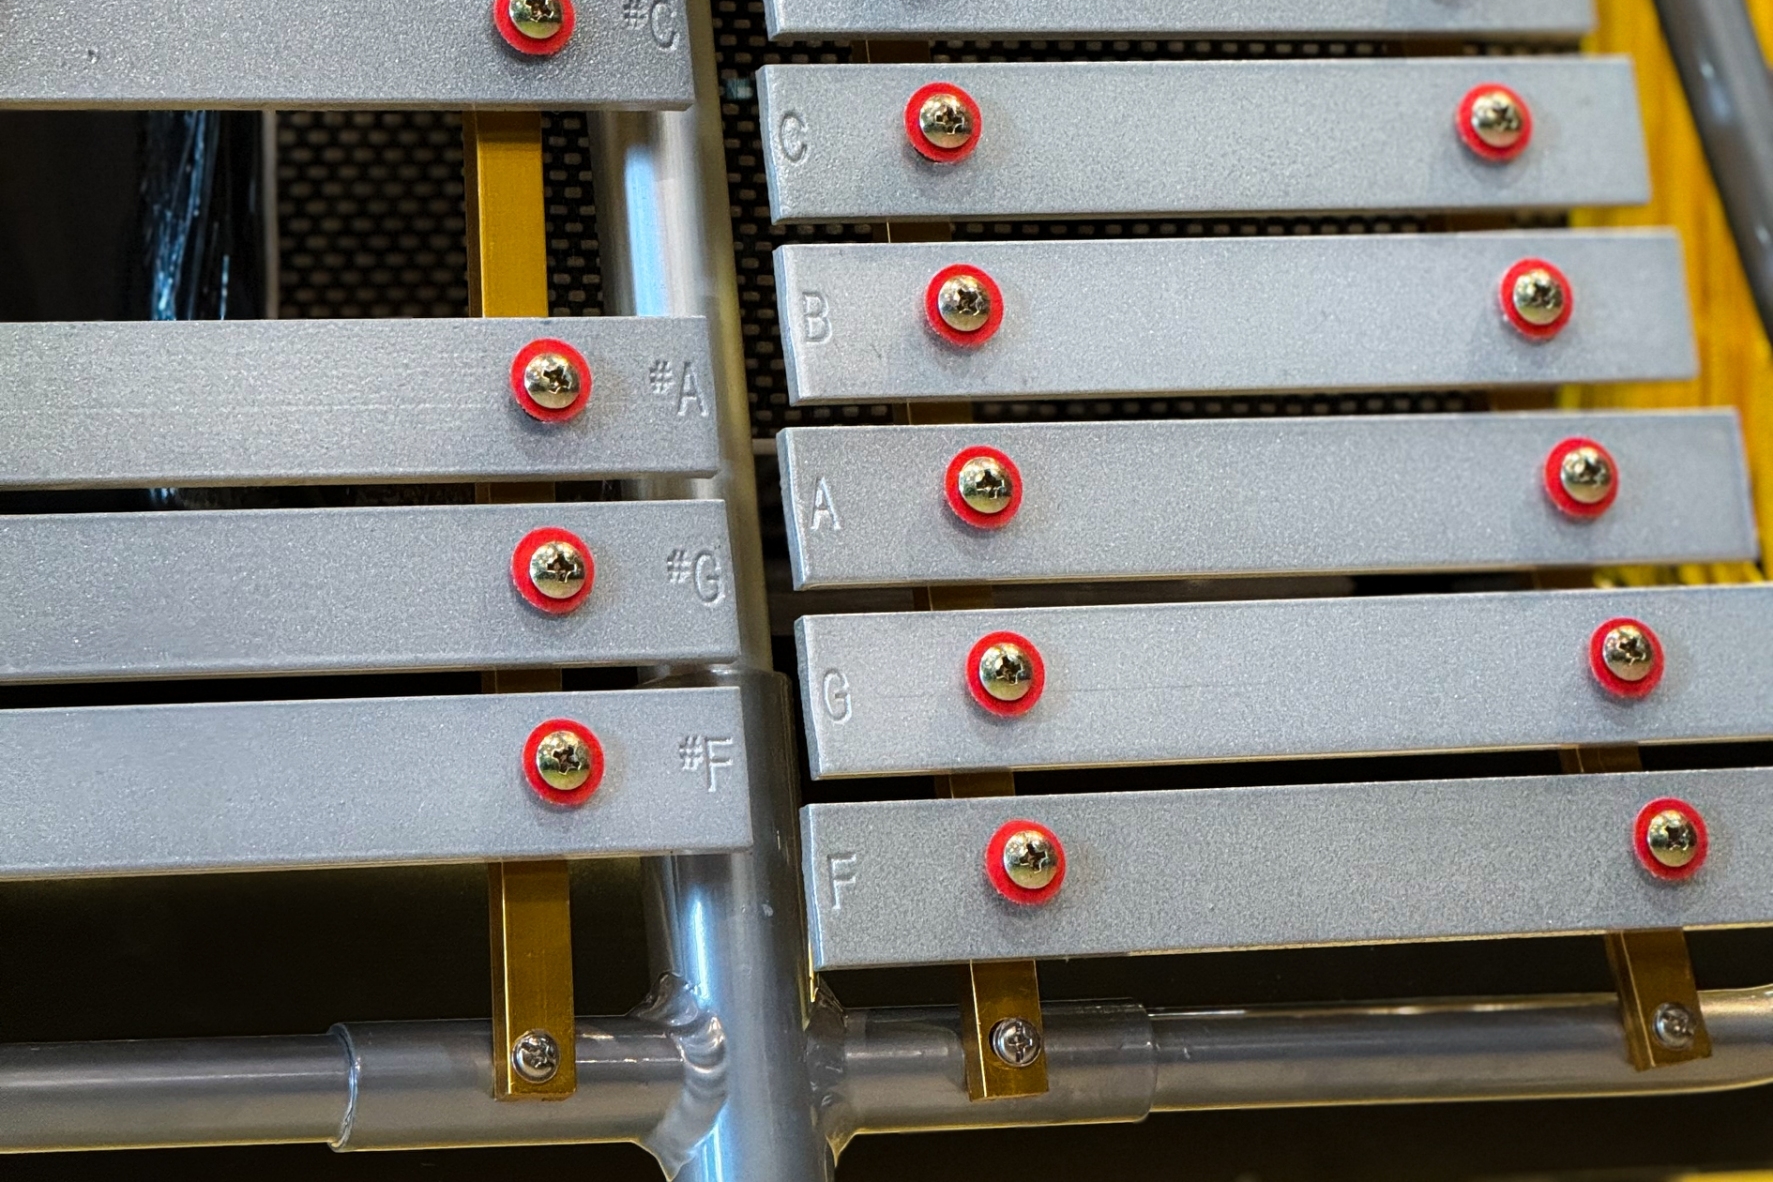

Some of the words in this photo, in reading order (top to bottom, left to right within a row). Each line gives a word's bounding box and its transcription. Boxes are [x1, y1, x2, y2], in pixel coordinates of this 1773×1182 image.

[780, 110, 808, 162] C
[802, 291, 833, 343] B
[650, 359, 710, 417] #A
[810, 477, 842, 530] A
[667, 548, 726, 606] #G
[823, 668, 852, 722] G
[679, 735, 733, 792] #F
[827, 852, 858, 910] F
